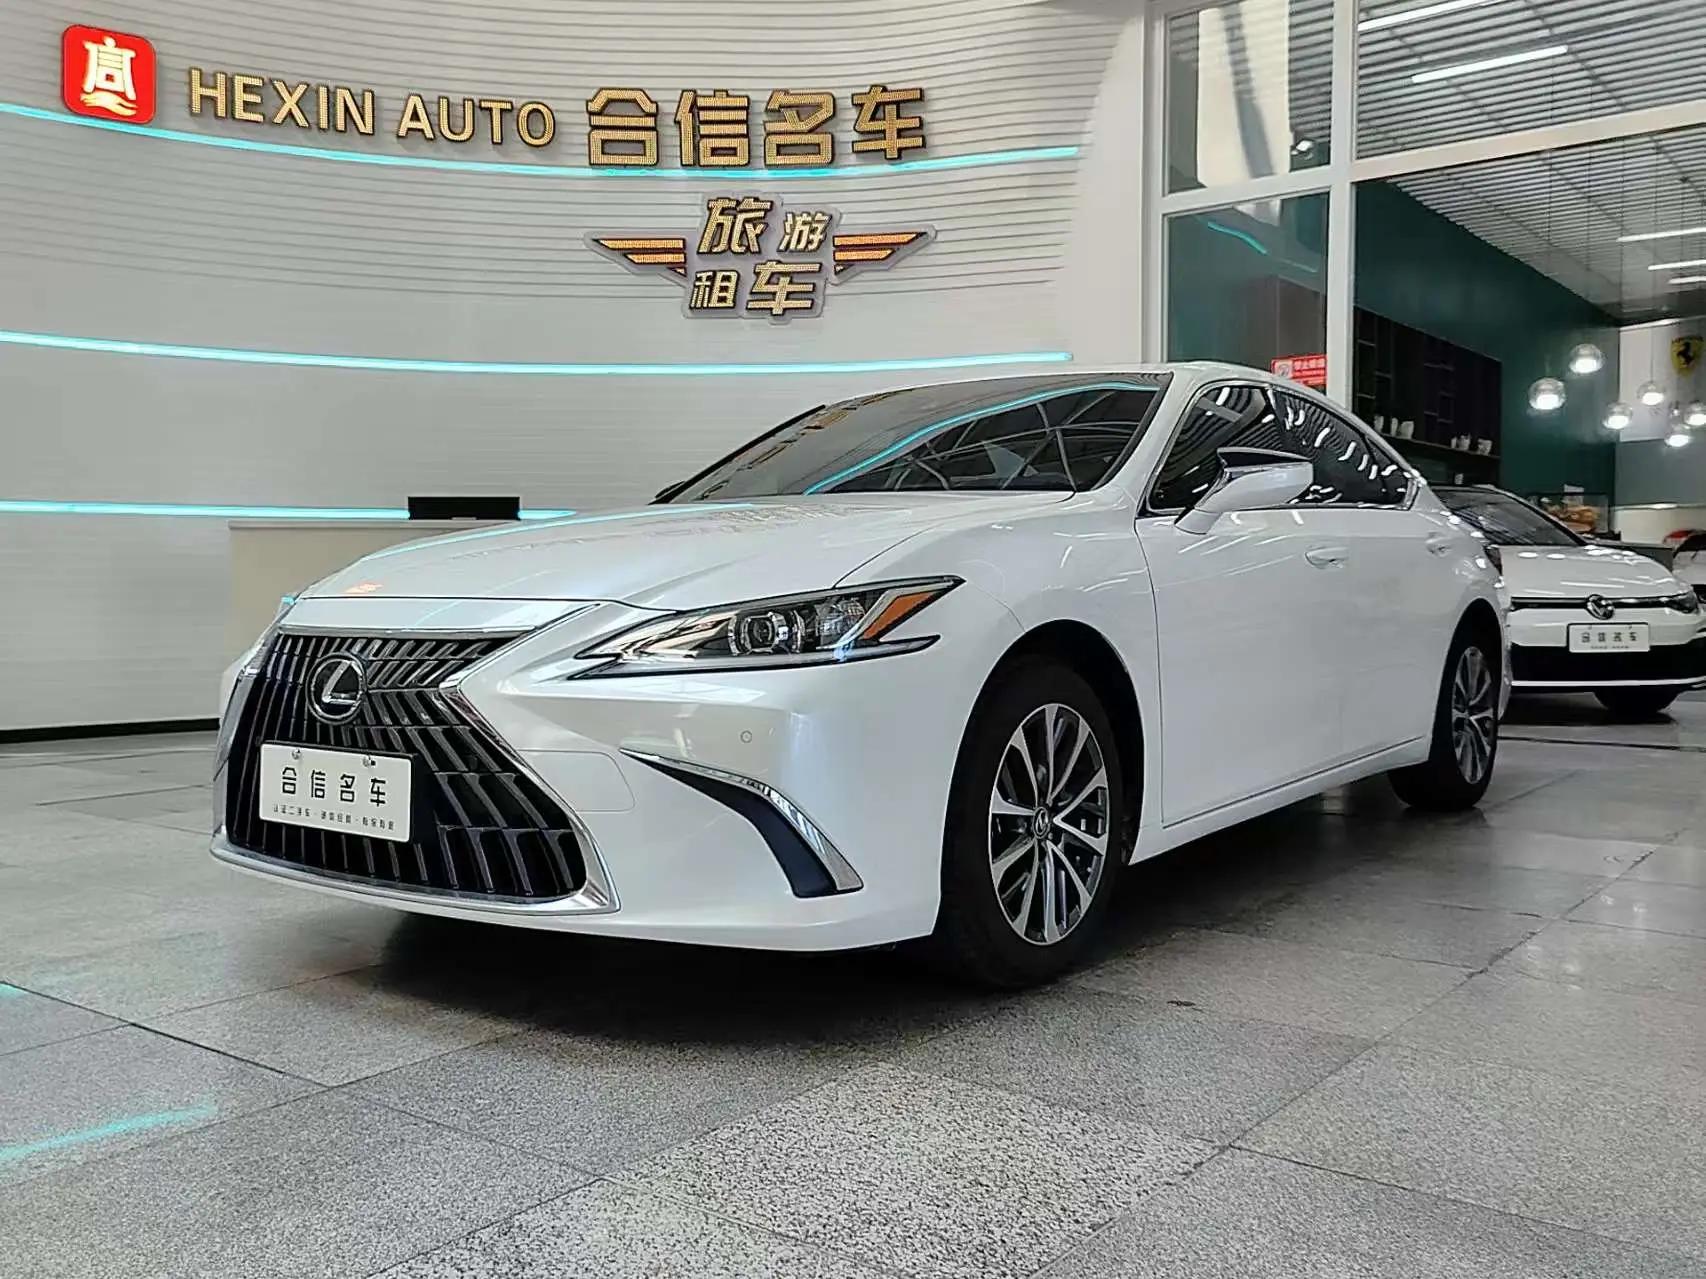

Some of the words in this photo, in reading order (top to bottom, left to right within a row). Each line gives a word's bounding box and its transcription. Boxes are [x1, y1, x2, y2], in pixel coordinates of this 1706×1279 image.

[188, 67, 376, 137] HEXIN
[397, 93, 557, 147] AUTO
[586, 84, 925, 167] 合信名车
[697, 196, 833, 255] 旅游
[689, 259, 823, 316] 租车
[281, 766, 387, 808] 合信名车
